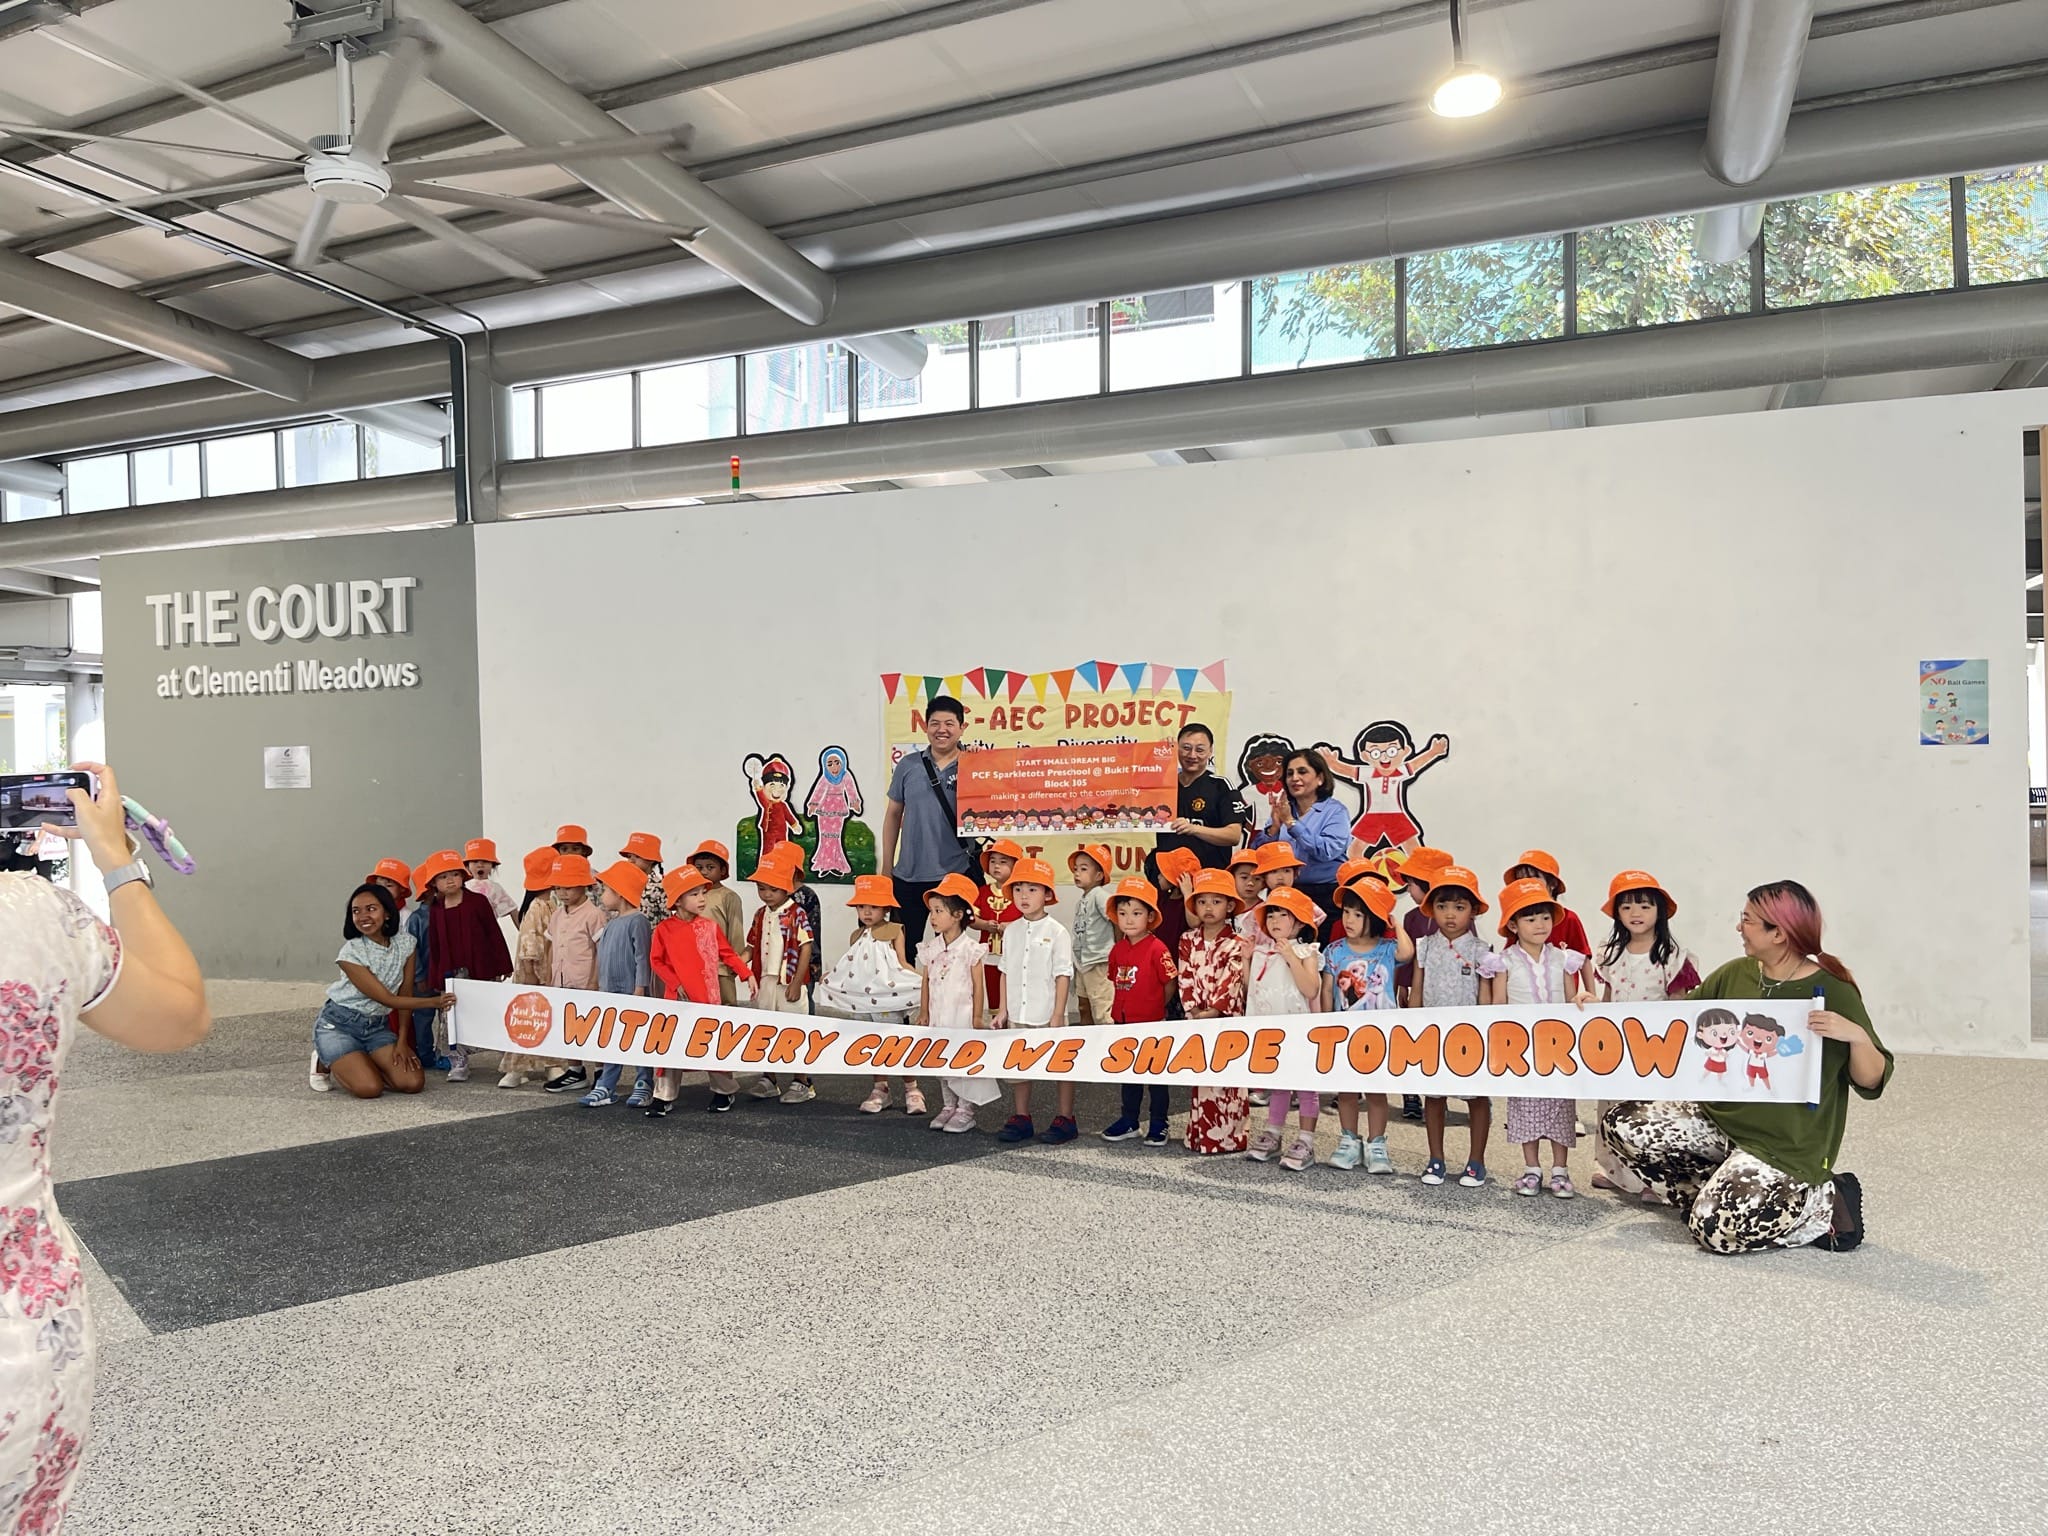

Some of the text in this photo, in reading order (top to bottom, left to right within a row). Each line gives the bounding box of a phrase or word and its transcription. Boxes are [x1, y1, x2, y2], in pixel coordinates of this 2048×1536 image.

[146, 576, 417, 647] THE COURT
[157, 658, 419, 697] at Clementi Meadows
[1064, 700, 1197, 729] PROJECT
[1016, 756, 1116, 767] START SMALL DREAM BIG
[972, 764, 1162, 780] PCF Sparkletots Preschool @ Bukit Timah
[1044, 780, 1070, 789] Block
[991, 791, 1019, 802] making
[1028, 791, 1067, 799] difference
[1080, 790, 1093, 798] the
[1095, 788, 1140, 798] community
[512, 1003, 549, 1017] Start Small
[510, 1016, 532, 1026] Dream
[563, 1001, 1688, 1079] WITH EVERY CHILD, WE SHAPE TOMORROW
